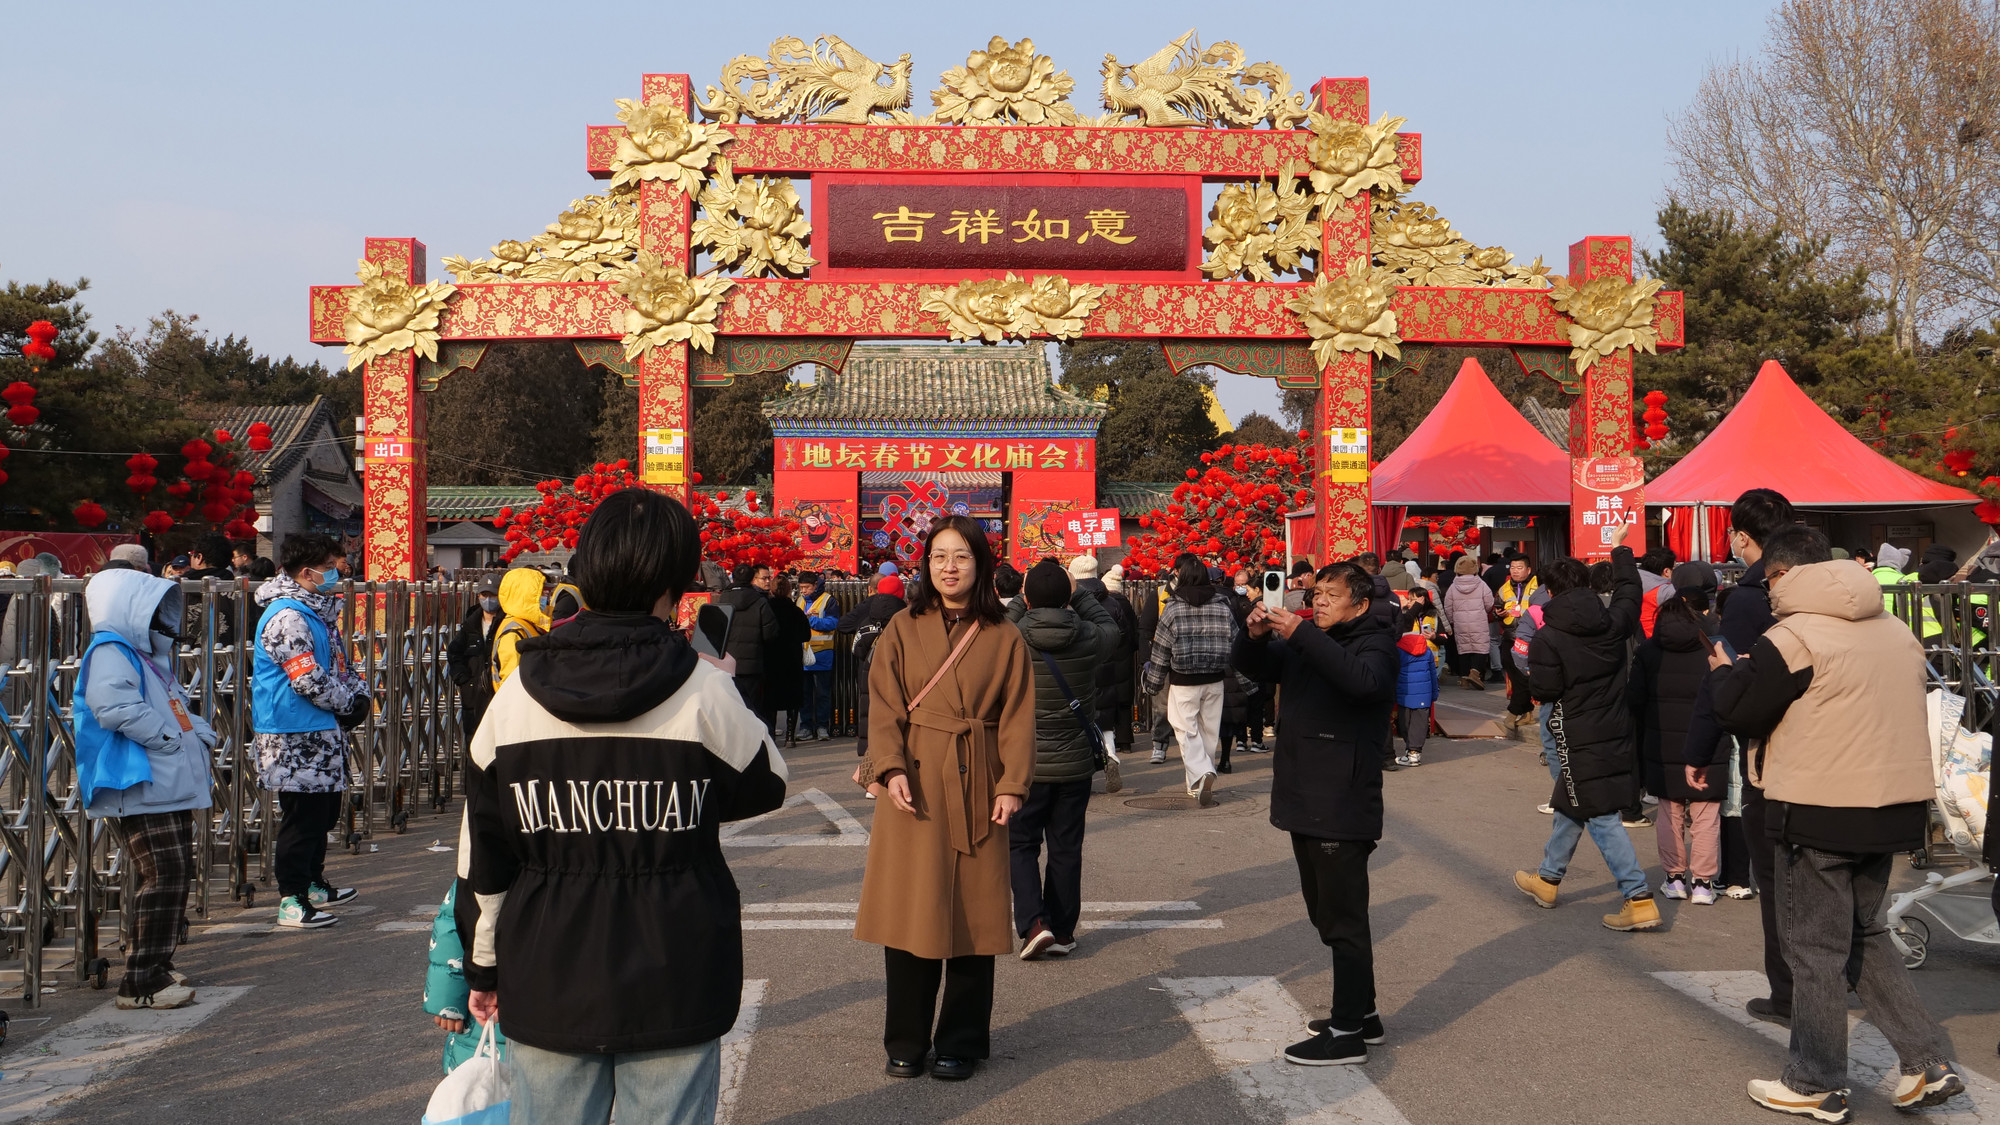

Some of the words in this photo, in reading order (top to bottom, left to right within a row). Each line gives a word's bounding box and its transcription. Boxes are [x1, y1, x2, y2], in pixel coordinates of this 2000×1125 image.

[872, 205, 1138, 245] 吉祥如意
[374, 442, 404, 457] 出口
[801, 442, 1069, 470] 地坛春节文化庙会
[646, 461, 683, 472] 验票通道
[1331, 460, 1367, 470] 验票通道
[1596, 495, 1624, 510] 庙会
[1067, 517, 1116, 533] 电子票
[1582, 511, 1638, 526] 南门入口
[1077, 531, 1108, 547] 验票
[509, 778, 712, 835] MANCHUAN
